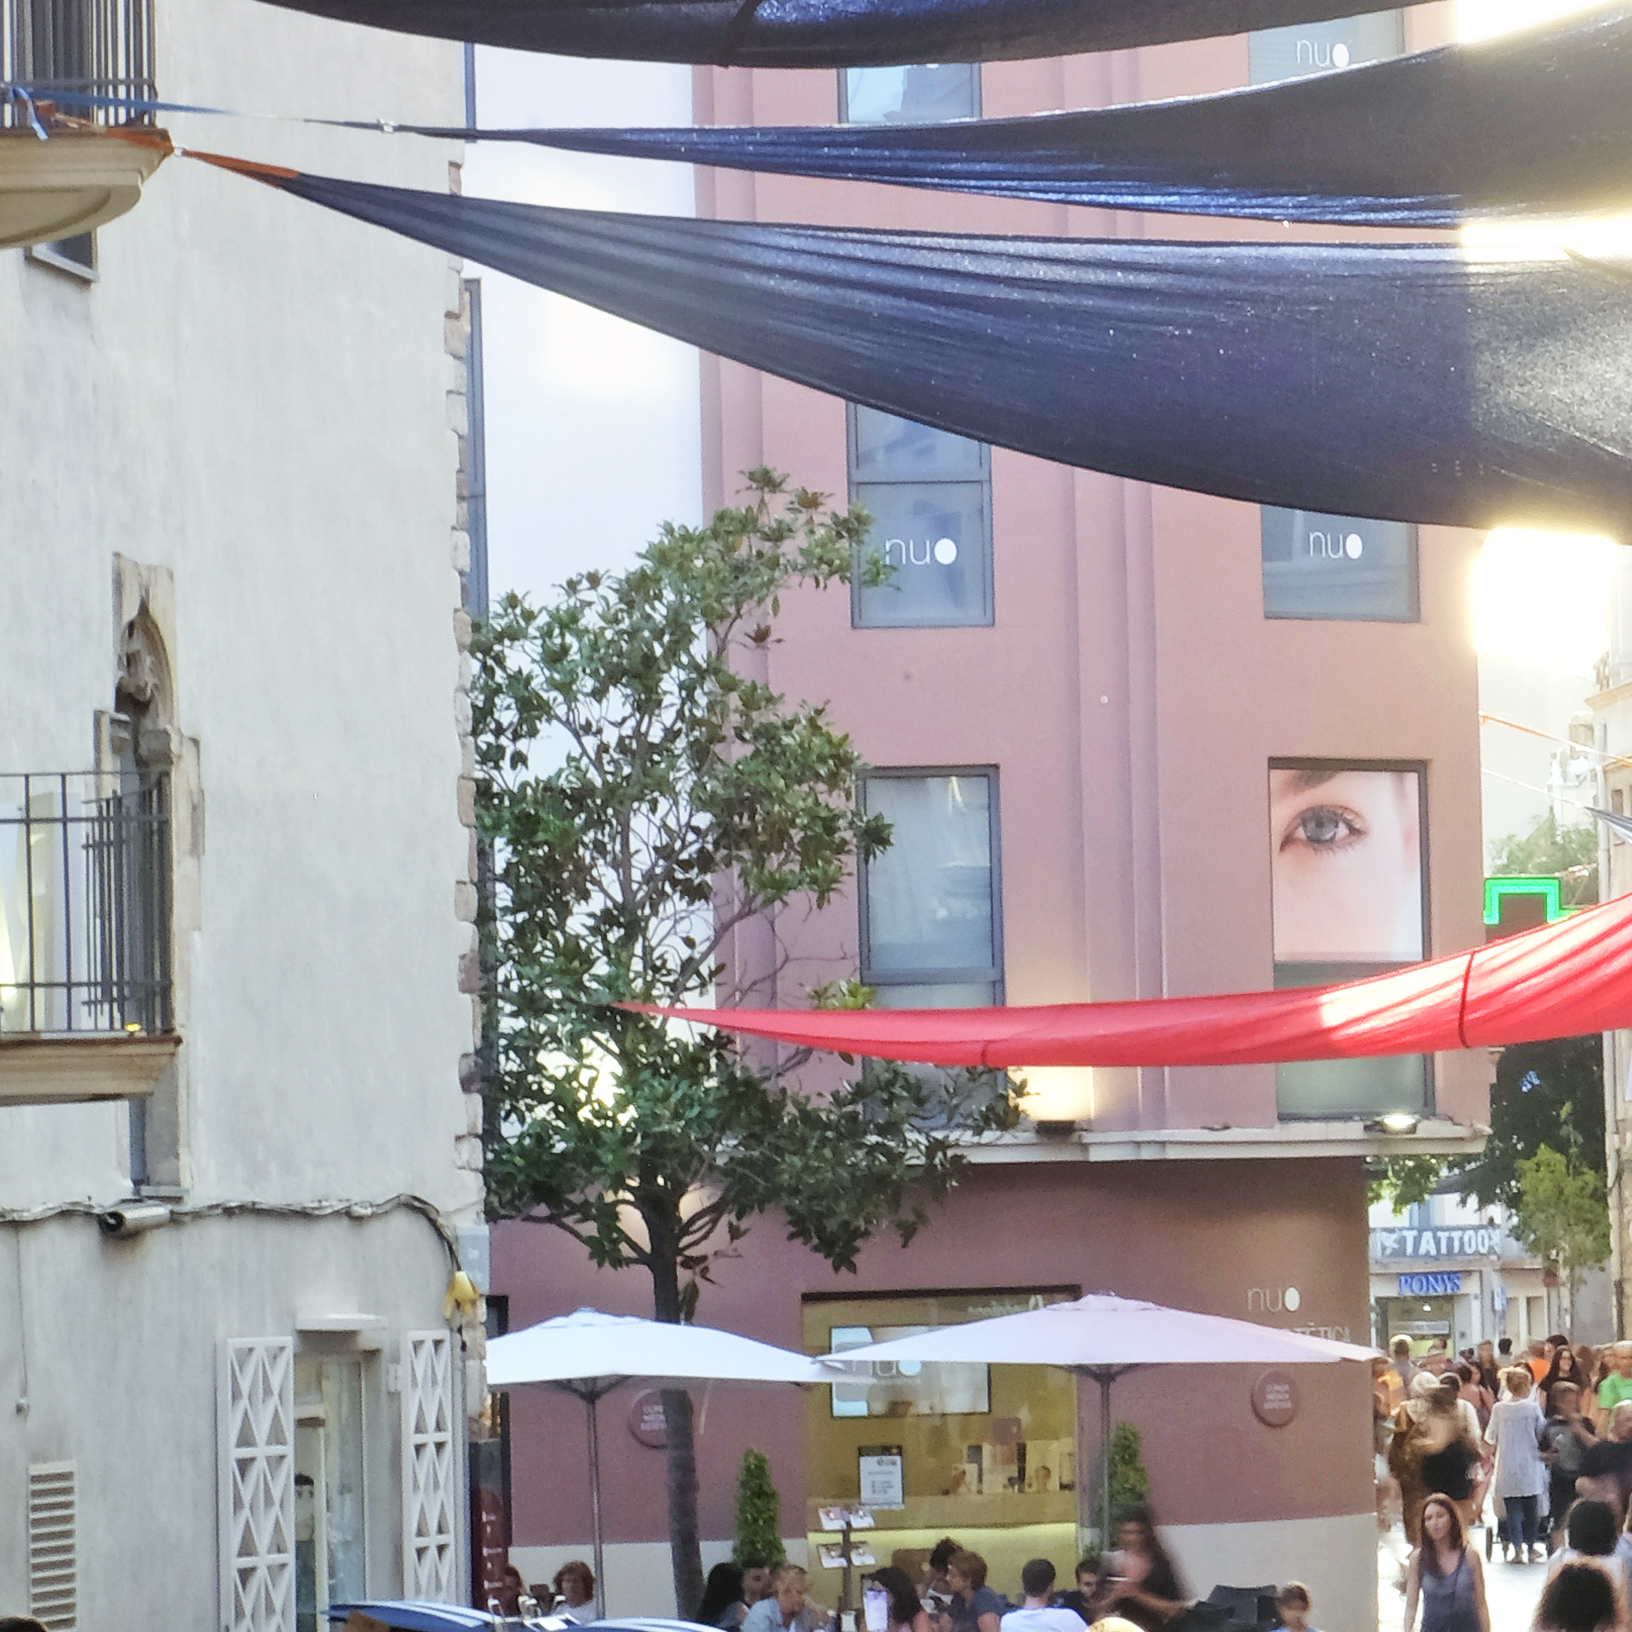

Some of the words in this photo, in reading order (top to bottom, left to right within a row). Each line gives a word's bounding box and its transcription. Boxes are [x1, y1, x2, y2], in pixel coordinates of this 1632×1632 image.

[1296, 40, 1350, 69] nuo
[885, 537, 957, 565] nuo
[1309, 531, 1363, 559] nuo
[1402, 1229, 1489, 1256] TATTOO
[1399, 1274, 1462, 1295] PONYS
[1247, 1286, 1301, 1312] nuo
